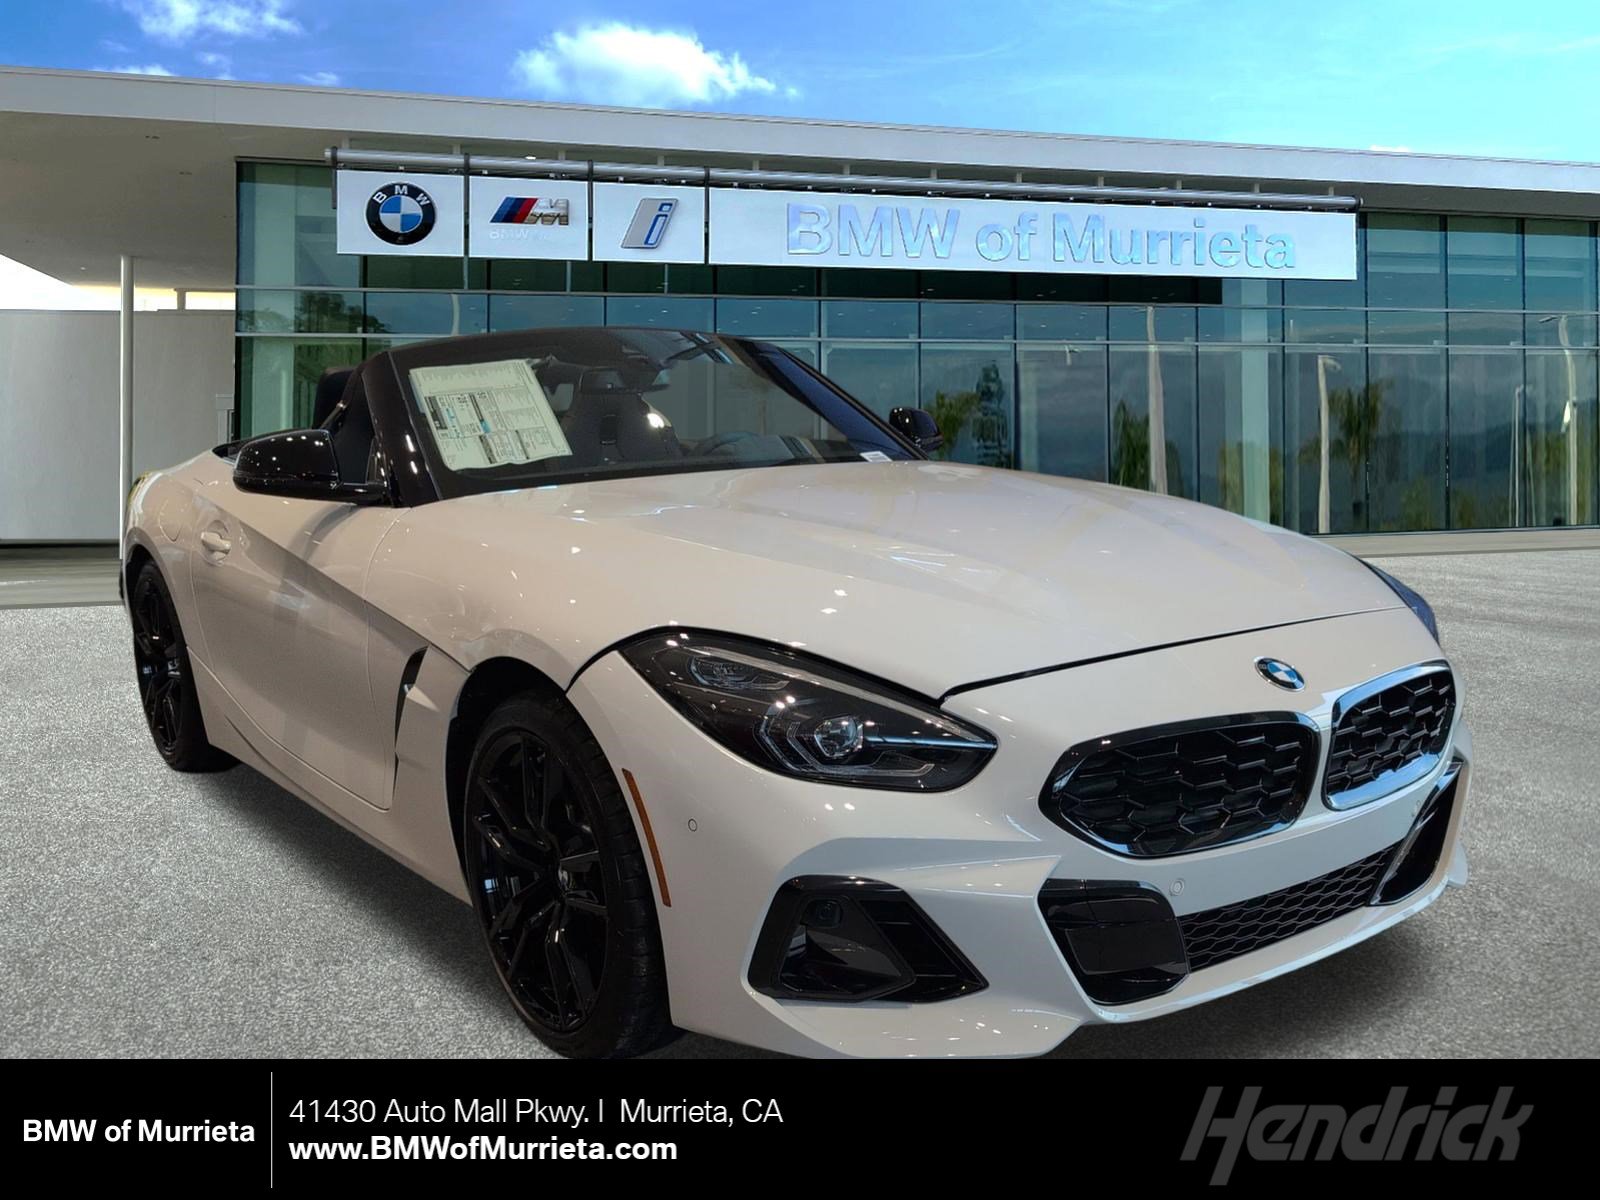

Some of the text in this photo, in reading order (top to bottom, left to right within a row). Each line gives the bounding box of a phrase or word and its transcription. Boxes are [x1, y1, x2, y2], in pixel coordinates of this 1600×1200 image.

[372, 184, 431, 206] BMW
[786, 202, 1295, 269] BMW of Murrieta
